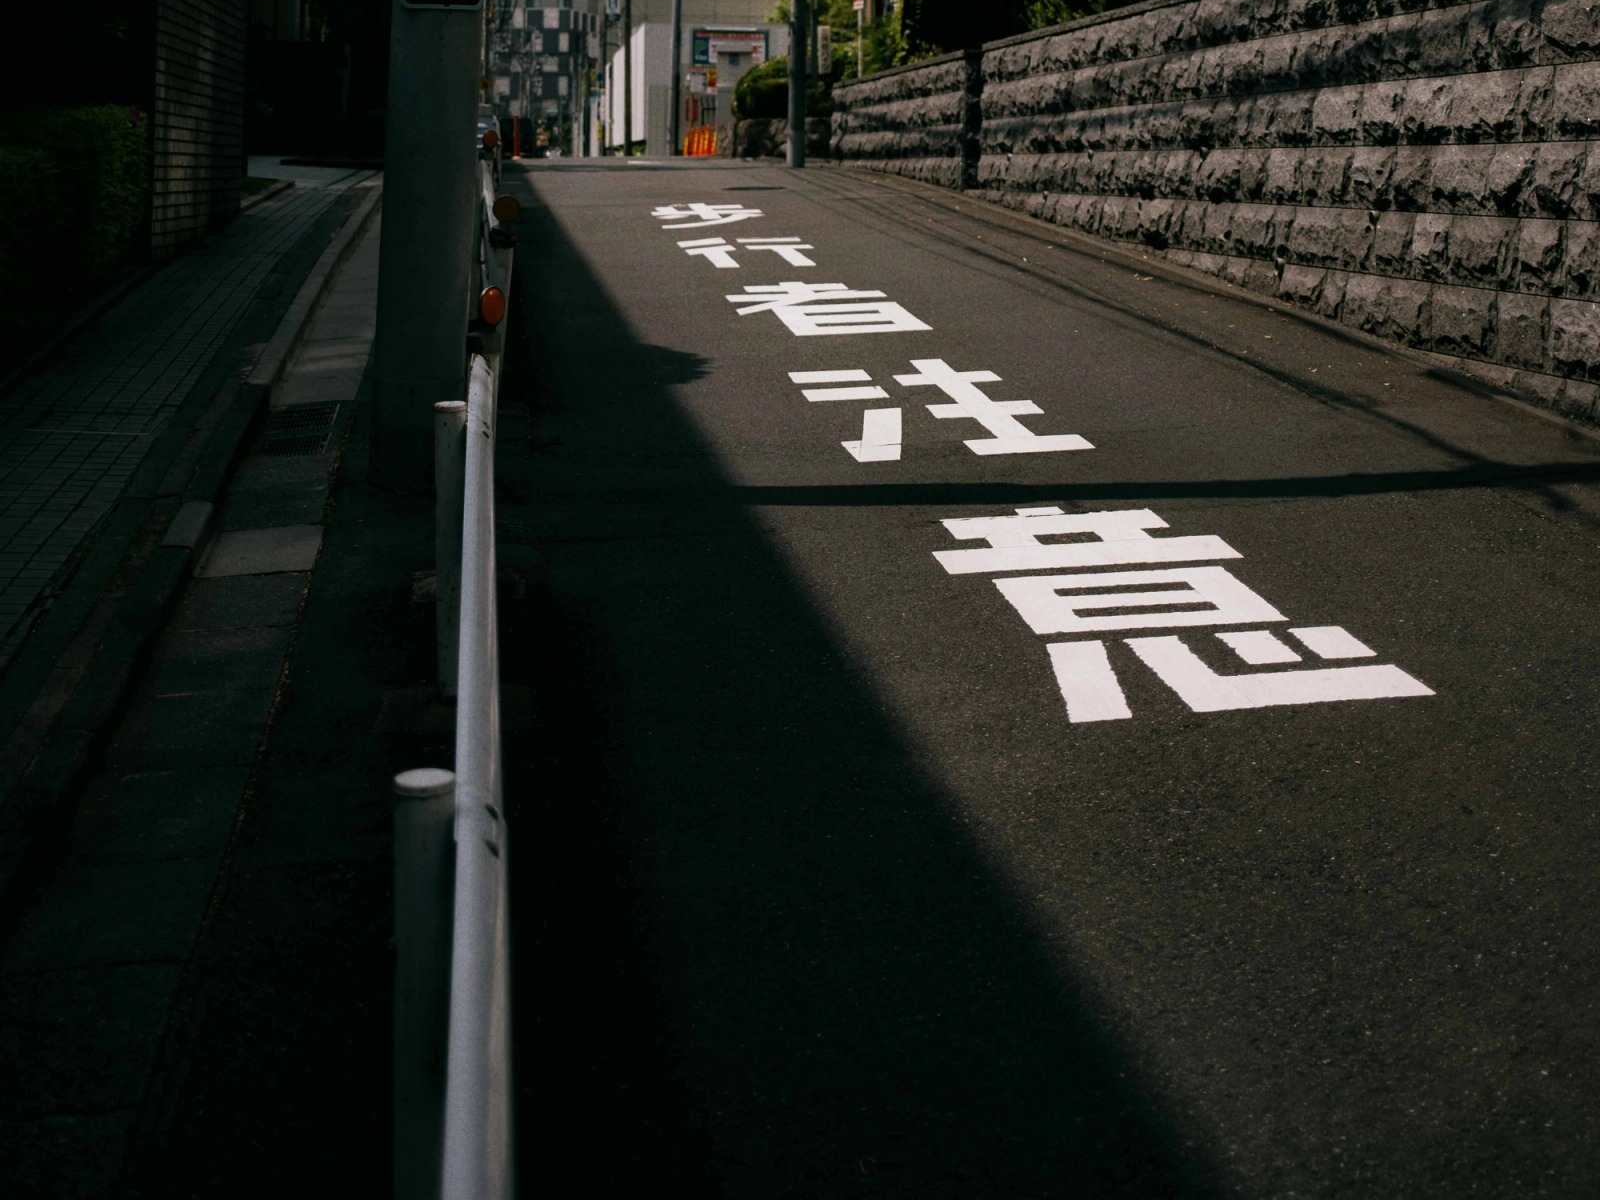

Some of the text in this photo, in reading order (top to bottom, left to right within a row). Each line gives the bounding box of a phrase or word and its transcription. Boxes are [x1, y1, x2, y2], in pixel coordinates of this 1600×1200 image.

[651, 202, 1437, 724] 歩行者注意
